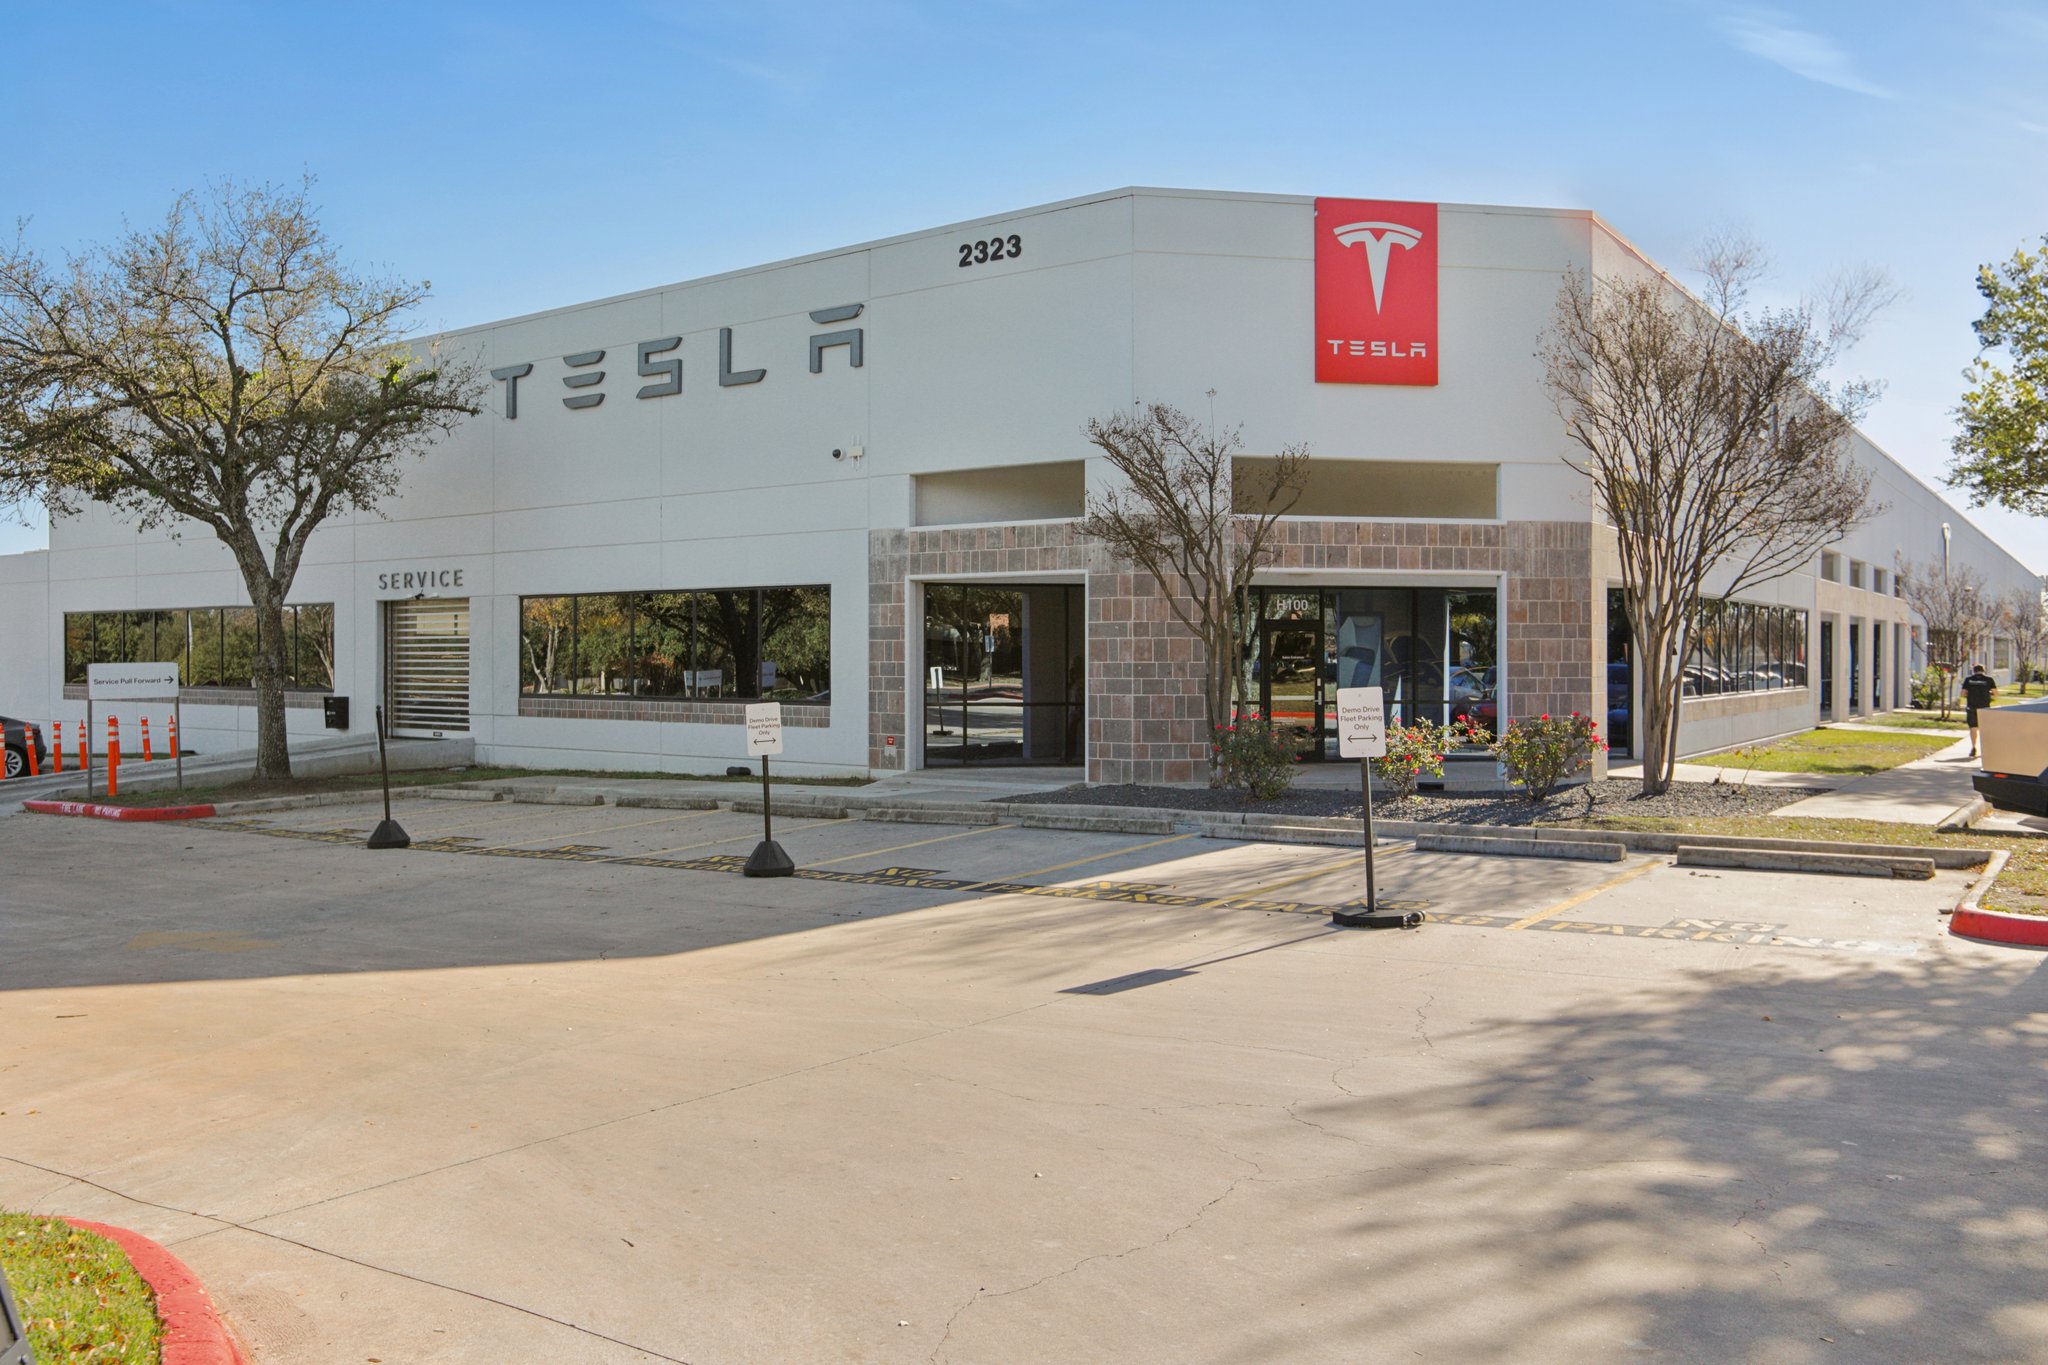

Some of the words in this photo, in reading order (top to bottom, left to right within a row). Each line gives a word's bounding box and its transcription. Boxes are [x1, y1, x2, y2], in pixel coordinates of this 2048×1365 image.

[958, 234, 1022, 268] 2323
[1327, 339, 1427, 358] TESLA
[490, 303, 864, 419] TESLA
[378, 569, 464, 590] SERVICE
[1276, 599, 1309, 611] H100
[93, 678, 119, 686] Service
[1342, 706, 1361, 714] Demo
[1358, 715, 1383, 723] Parking
[1354, 723, 1370, 731] Only
[1674, 918, 1776, 932] NO
[1549, 921, 1882, 952] PARKING
